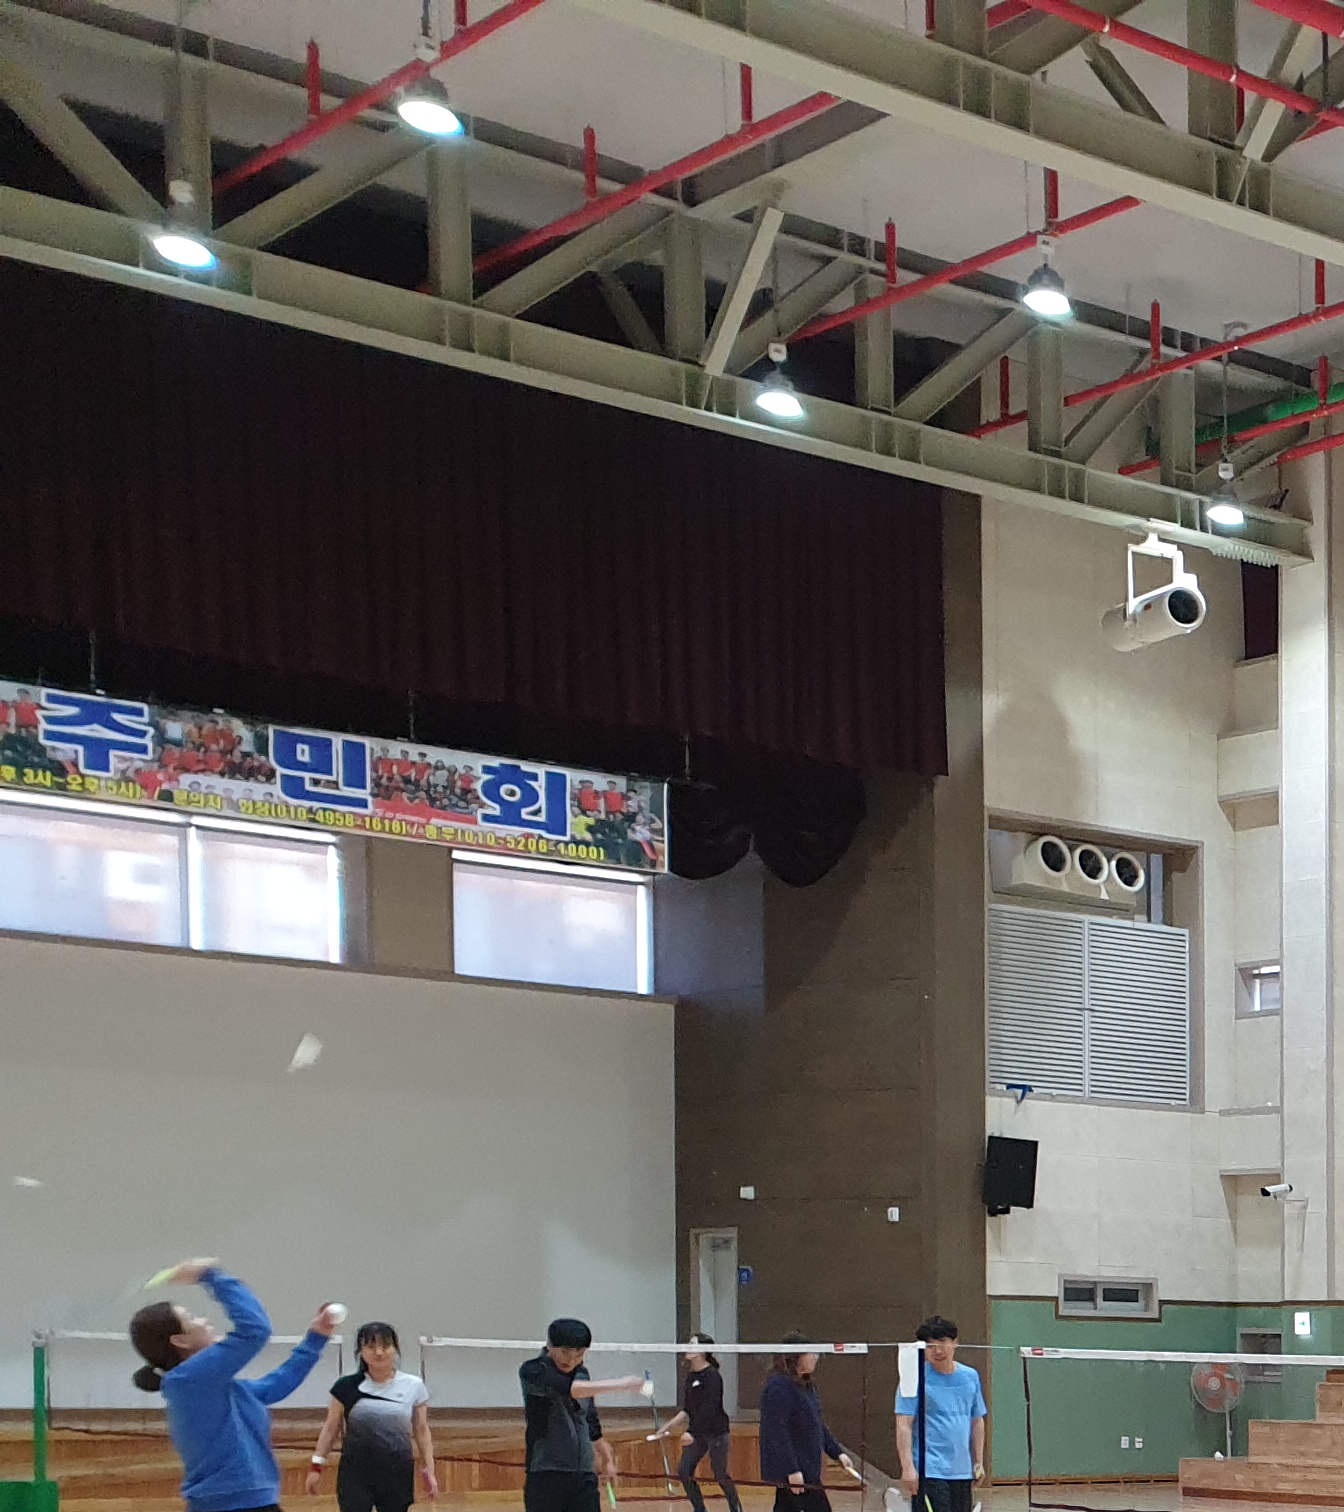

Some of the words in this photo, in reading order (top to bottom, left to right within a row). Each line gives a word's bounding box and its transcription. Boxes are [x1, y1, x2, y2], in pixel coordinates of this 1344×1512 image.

[38, 688, 153, 777] 주
[268, 725, 373, 811] 민
[477, 760, 574, 838] 회
